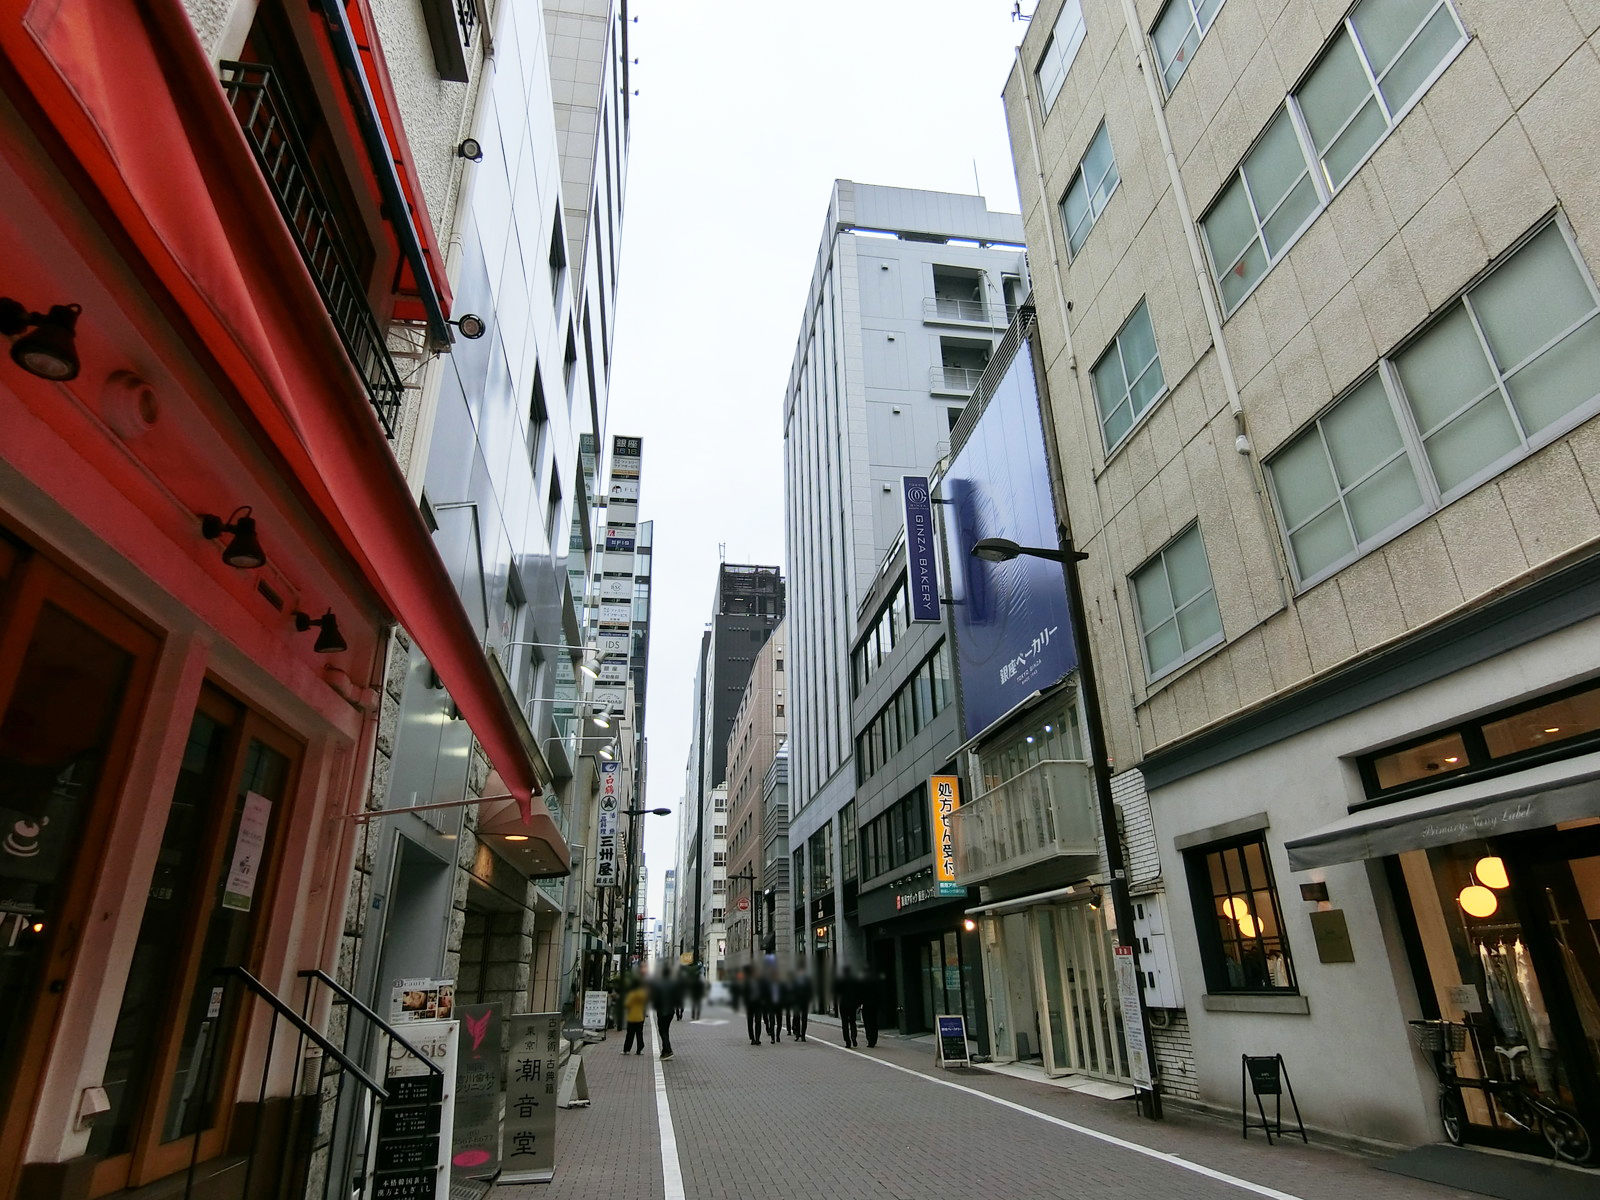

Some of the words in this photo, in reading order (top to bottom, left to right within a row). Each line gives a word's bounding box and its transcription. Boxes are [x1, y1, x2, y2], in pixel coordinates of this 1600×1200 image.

[916, 514, 926, 553] GINZA
[920, 558, 931, 610] BAKERY
[606, 640, 620, 649] IDS
[1000, 626, 1058, 685] 銀座ベーカリー
[1502, 803, 1532, 822] Label
[598, 836, 614, 876] 三州屋
[525, 1026, 535, 1050] 東京
[510, 1058, 542, 1157] 潮音堂
